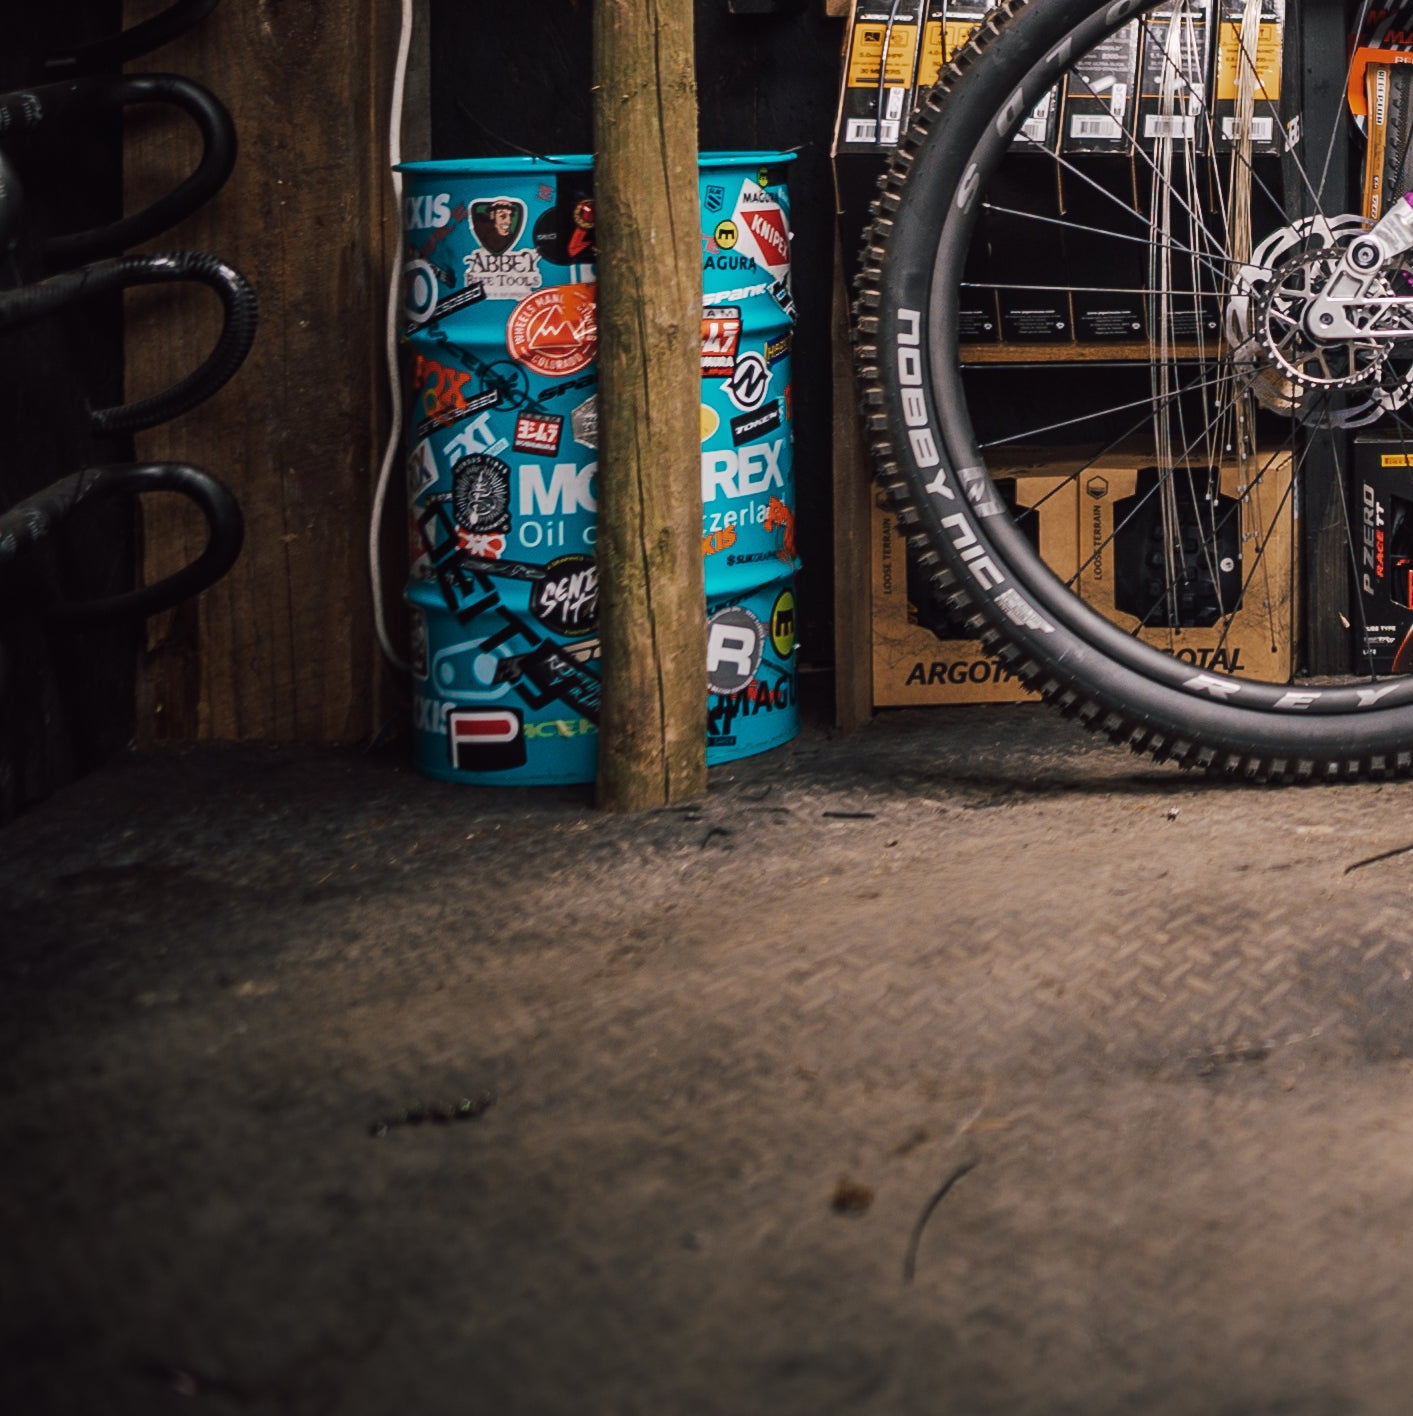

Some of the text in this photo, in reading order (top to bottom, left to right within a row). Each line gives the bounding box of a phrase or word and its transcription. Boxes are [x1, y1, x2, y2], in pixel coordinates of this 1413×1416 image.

[751, 214, 789, 258] KNIPEX
[467, 252, 541, 273] ABBEY
[704, 256, 757, 272] AGURA
[499, 274, 540, 287] TOOLS
[530, 350, 585, 372] COLORADO
[735, 412, 778, 435] TOKEN
[896, 307, 1006, 591] NOBBY NIC
[519, 521, 565, 547] Oil
[1094, 504, 1103, 581] LOOSE TERRAIN
[1363, 483, 1376, 597] P ZERO
[1375, 501, 1385, 579] RACE TT
[883, 517, 893, 595] LOOSE TERRAIN
